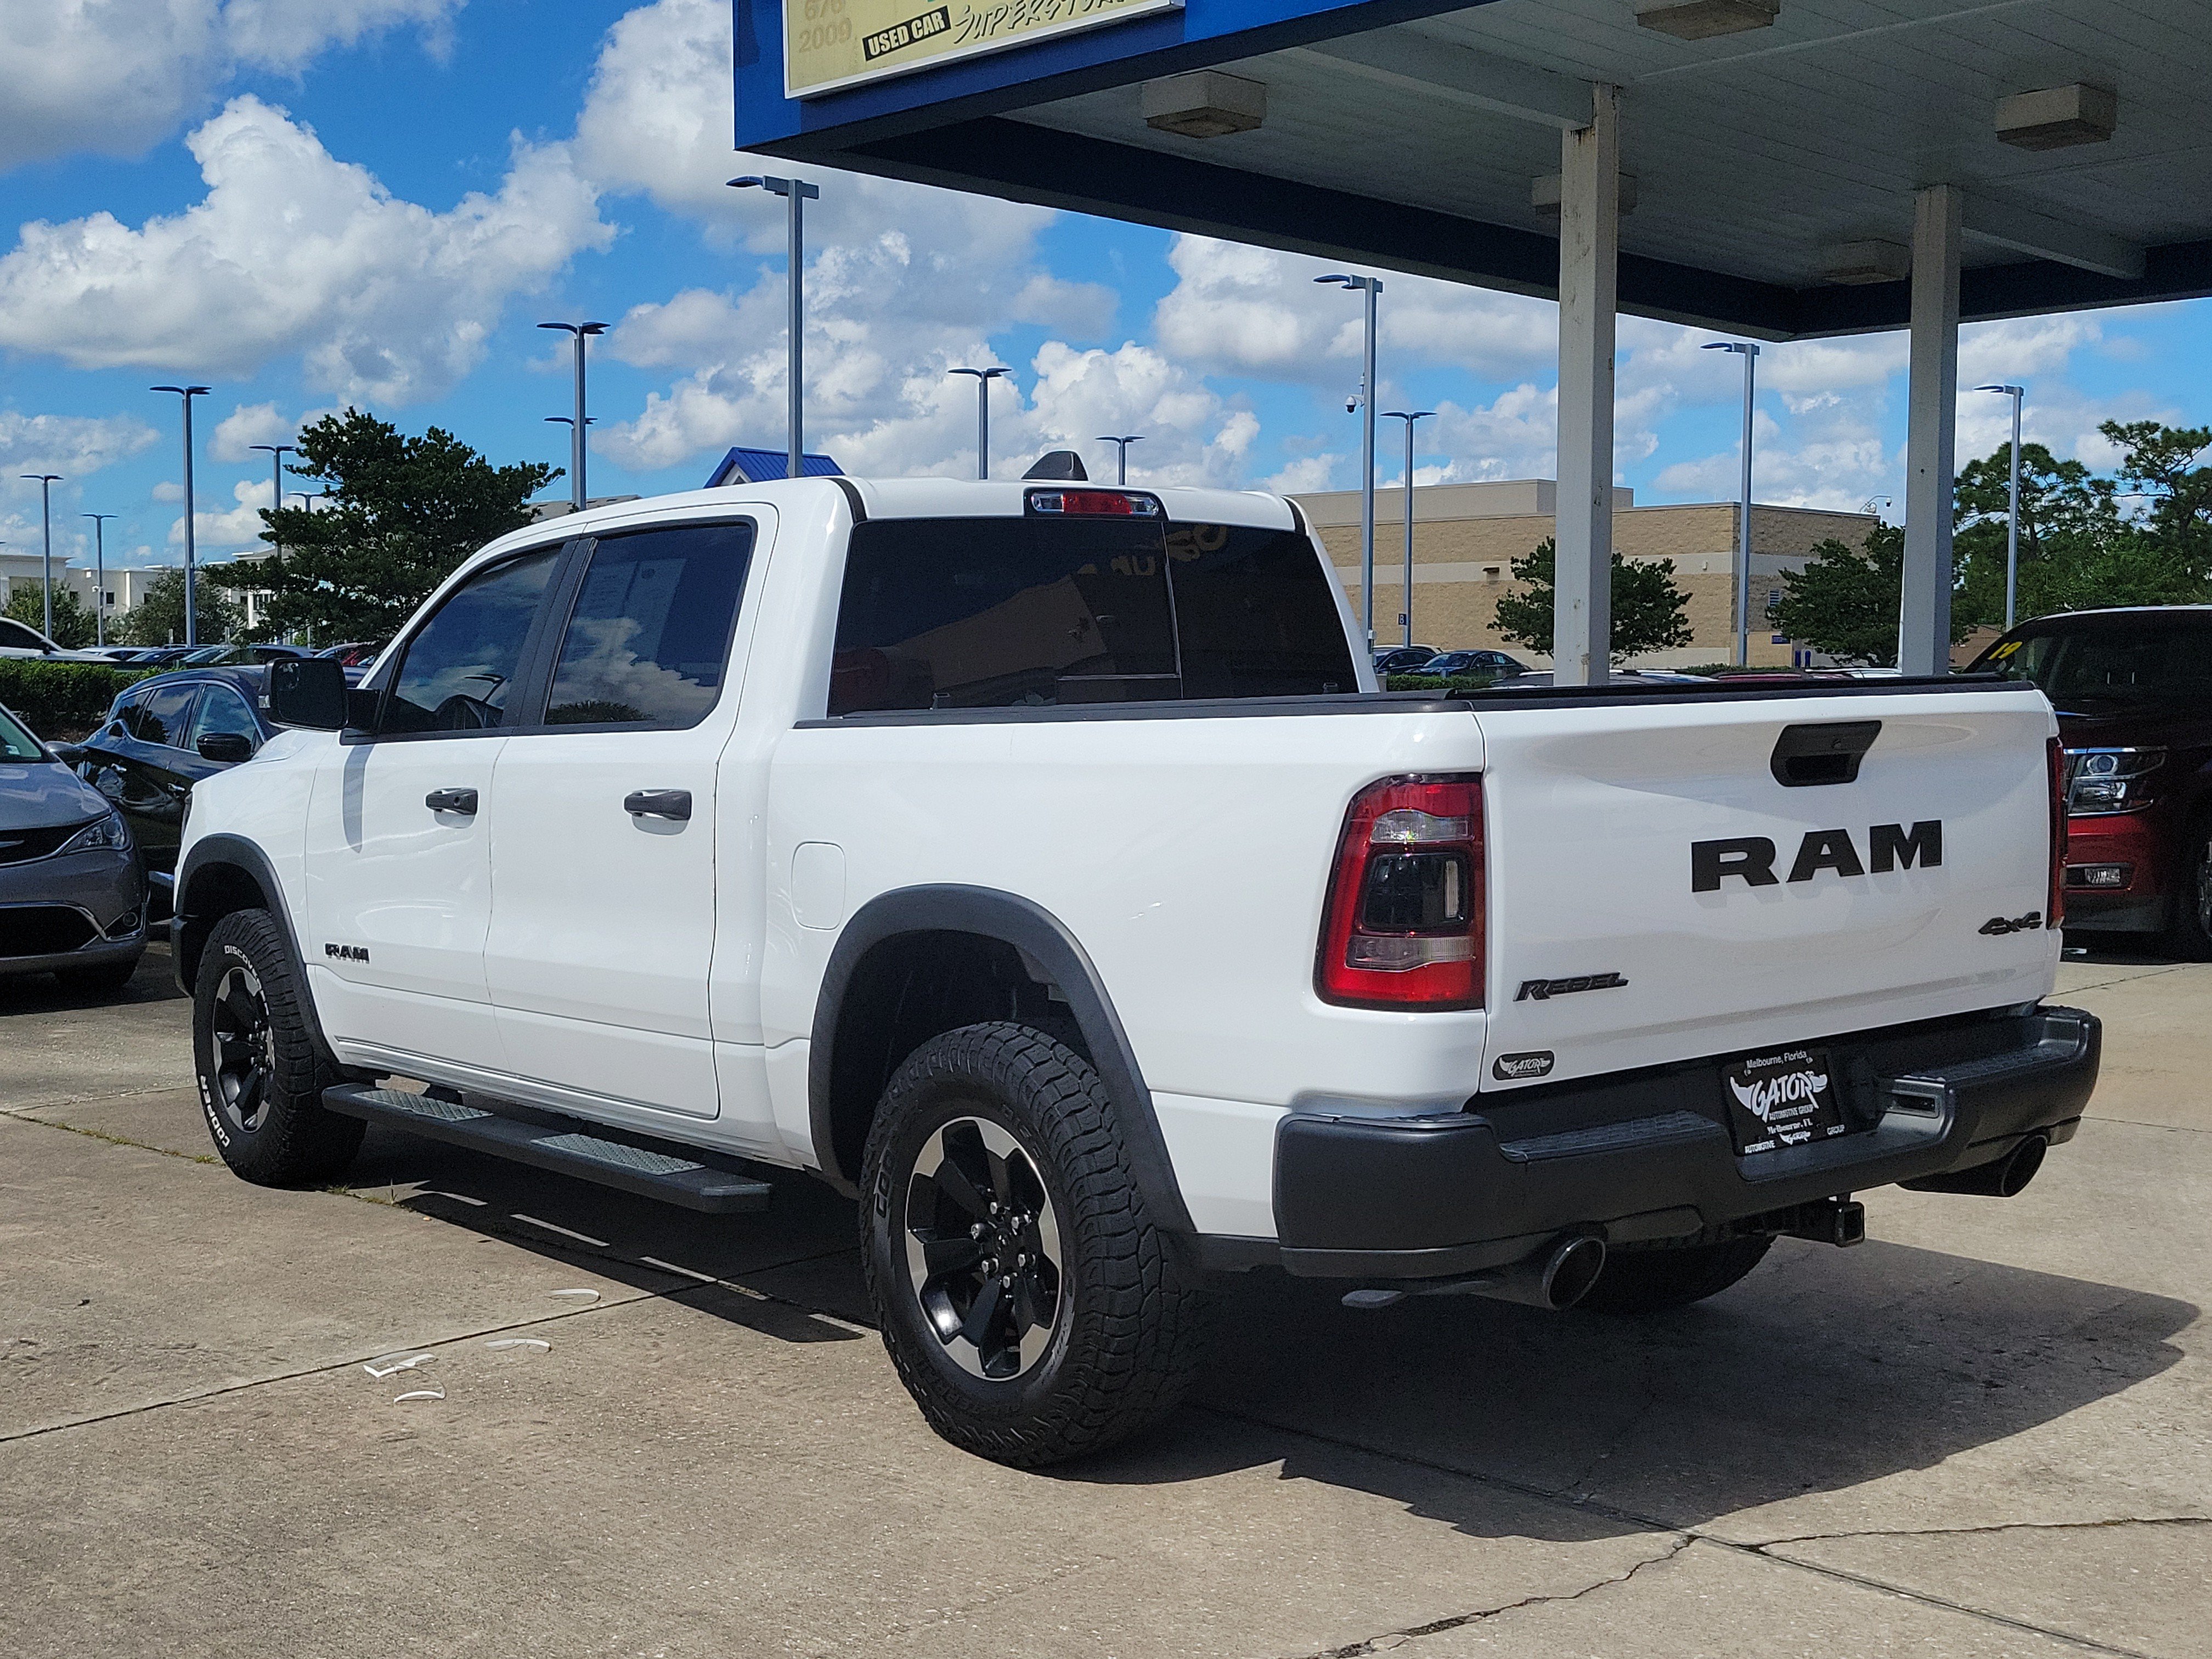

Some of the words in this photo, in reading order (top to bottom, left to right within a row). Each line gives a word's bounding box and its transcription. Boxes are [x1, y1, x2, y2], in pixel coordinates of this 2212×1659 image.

[868, 25, 910, 56] USED
[911, 11, 945, 40] CAR
[1691, 820, 1942, 893] RAM
[325, 943, 370, 962] RAM
[1508, 1058, 1541, 1076] GATOR
[1746, 1056, 1784, 1068] Melbourne,
[1784, 1050, 1807, 1062] Florida
[1751, 1072, 1819, 1123] GATOR
